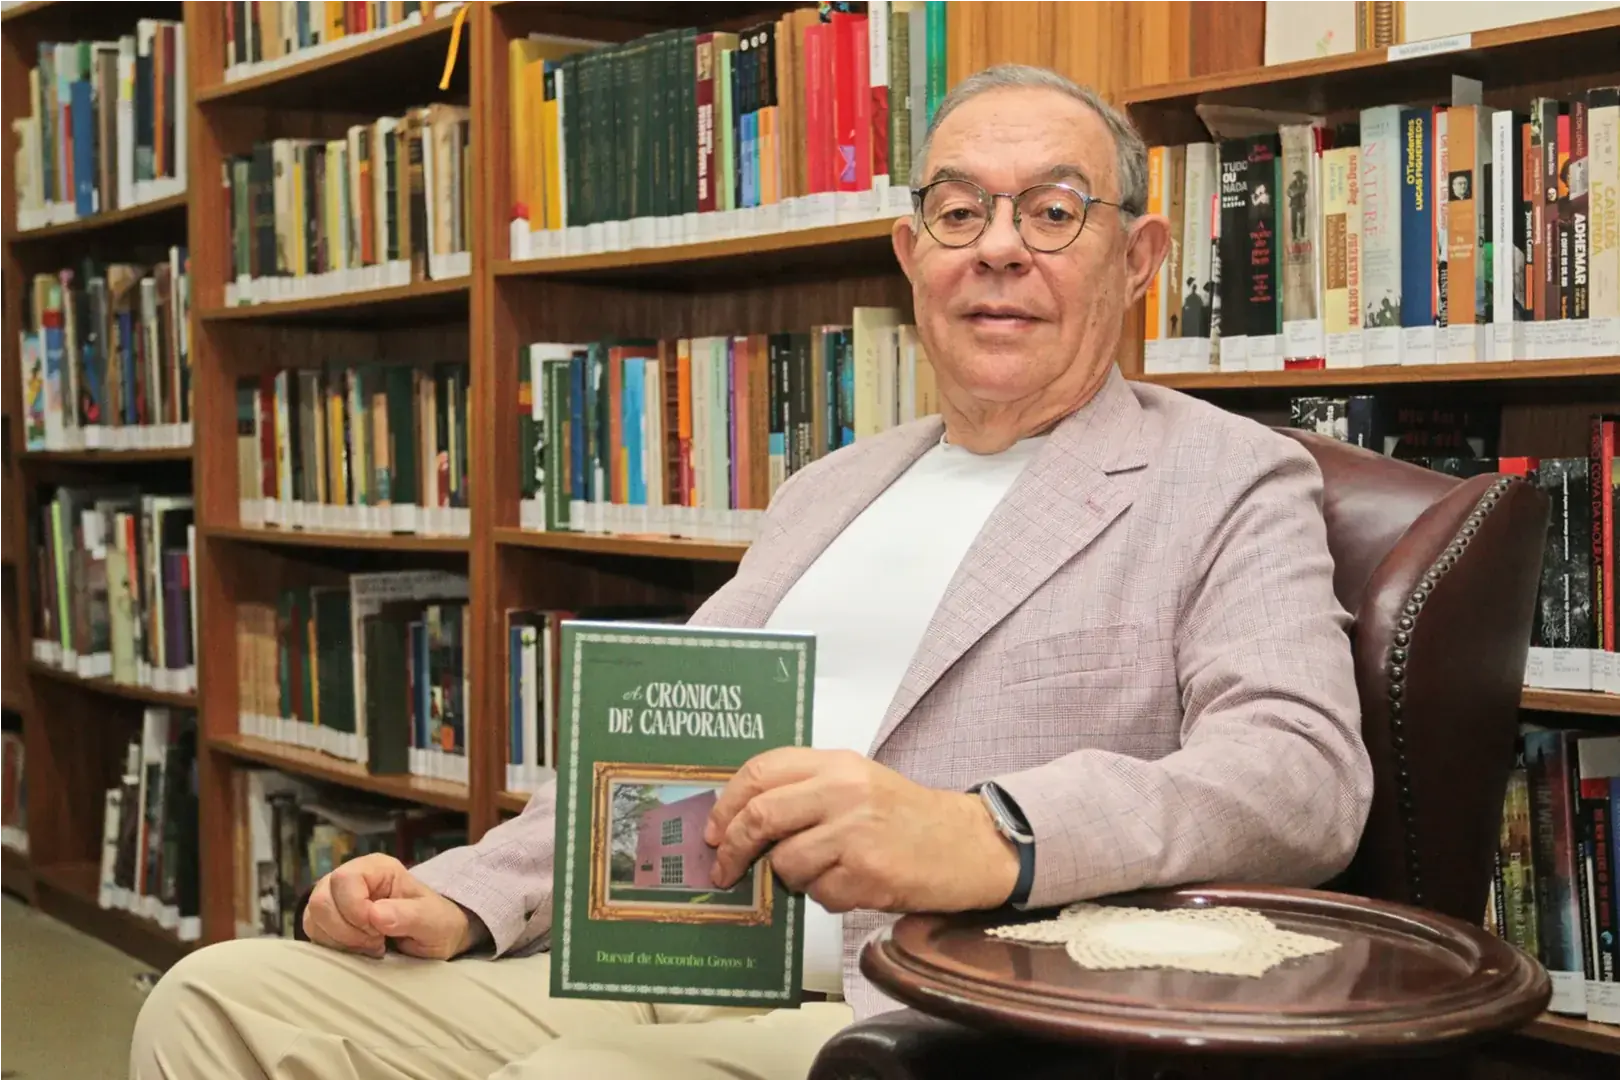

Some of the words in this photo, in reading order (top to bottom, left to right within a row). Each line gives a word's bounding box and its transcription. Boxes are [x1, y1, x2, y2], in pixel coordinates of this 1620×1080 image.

[1406, 119, 1415, 175] Tiradentes
[1415, 118, 1424, 178] FIGUEIREDO
[1222, 171, 1237, 184] OU
[1223, 161, 1248, 172] TUDO
[1406, 174, 1415, 184] O
[1223, 181, 1248, 194] NADA
[1363, 142, 1378, 236] NATURE
[1415, 178, 1424, 211] LUCAS
[1592, 181, 1603, 257] LACERDA
[1604, 186, 1616, 249] CARLOS
[1574, 212, 1587, 285] ADHEMAR
[1591, 462, 1601, 498] COVA
[1591, 500, 1601, 518] DA
[1592, 521, 1602, 566] MOURA
[608, 707, 634, 735] DE
[639, 708, 765, 740] CAAPORANGA
[596, 950, 634, 965] Durval
[637, 951, 653, 965] de
[707, 954, 743, 972] Goyos
[1602, 951, 1613, 970] JOHN
